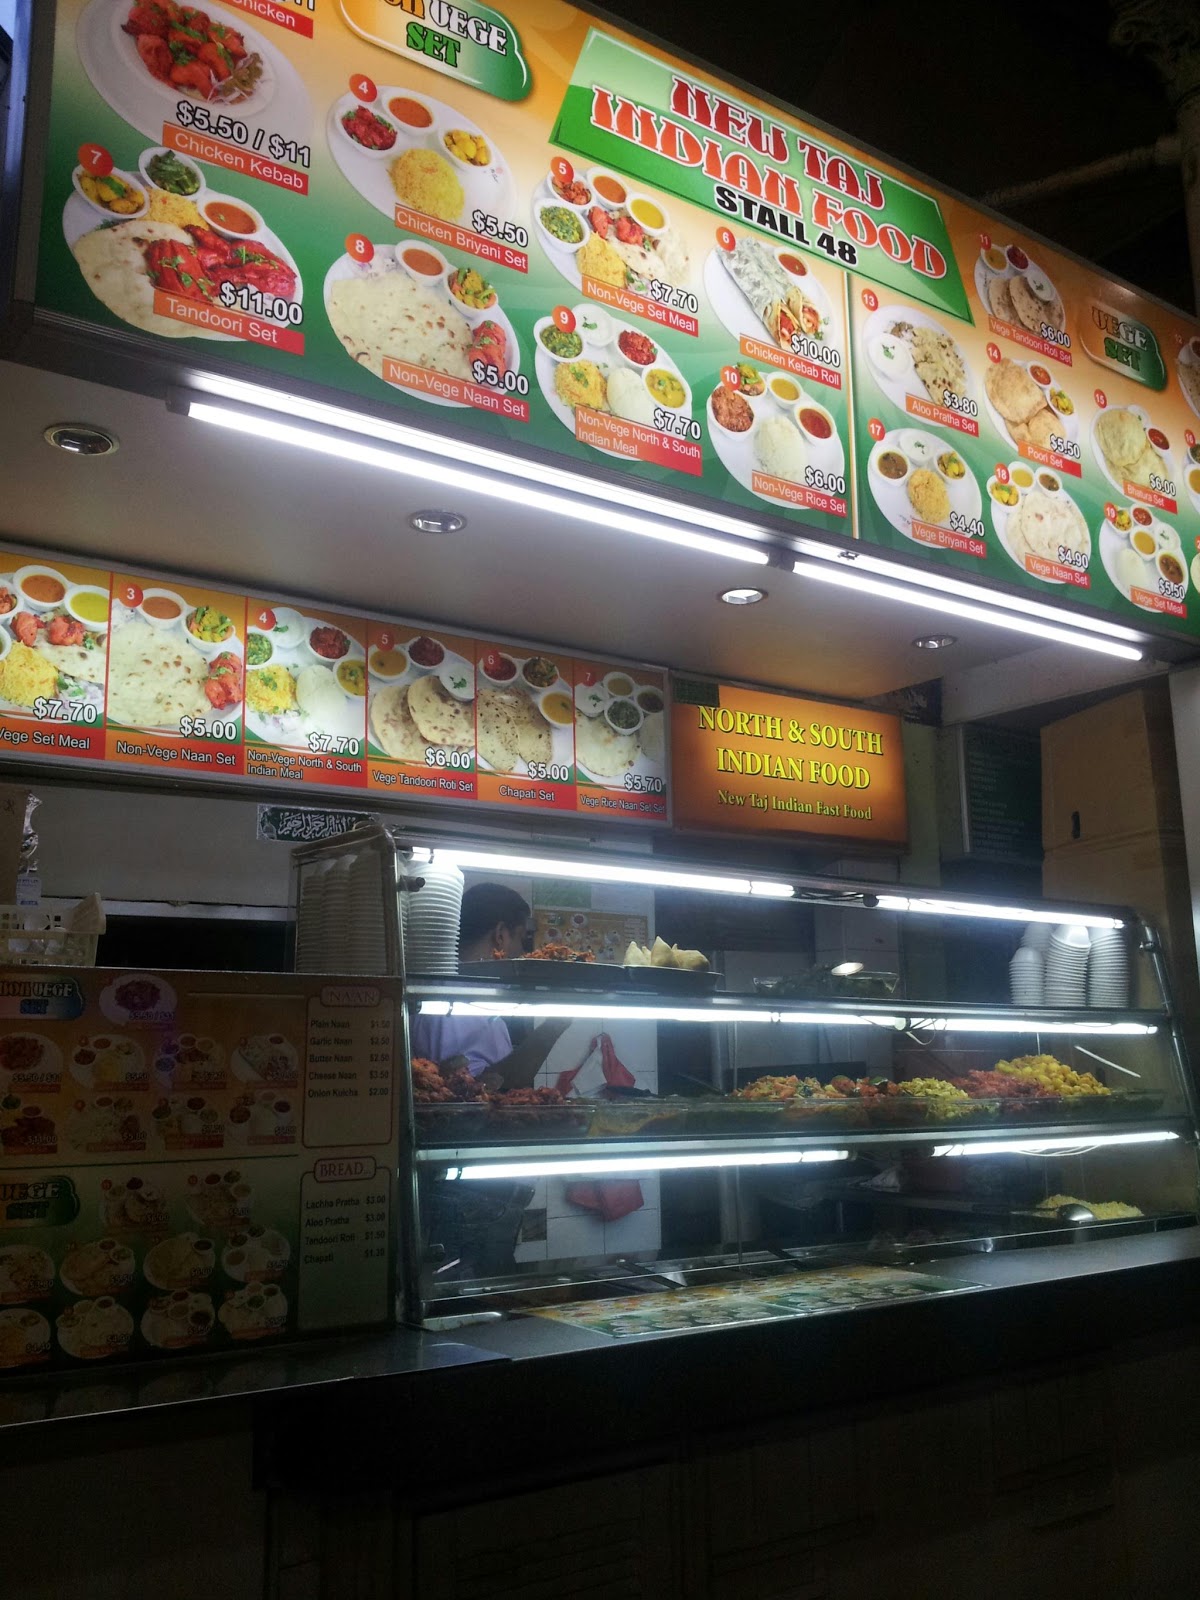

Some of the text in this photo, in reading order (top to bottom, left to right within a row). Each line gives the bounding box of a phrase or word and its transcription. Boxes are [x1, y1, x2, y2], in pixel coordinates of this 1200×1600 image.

[406, 22, 461, 68] SET
[358, 82, 369, 94] 4
[176, 101, 311, 168] $5.50 / $11
[669, 75, 886, 211] NEW TAJ
[91, 150, 101, 165] 7
[175, 133, 303, 189] Chicken Kebab
[558, 163, 567, 174] 5
[591, 84, 947, 280] INDIAN FOOD
[472, 210, 528, 248] $5.50
[715, 184, 858, 267] STALL 48
[722, 231, 730, 242] 6
[355, 240, 365, 253] 8
[397, 212, 527, 269] Chicken Briyani Set
[980, 234, 989, 246] 11
[220, 281, 303, 325] $11.00
[587, 281, 695, 332] Non-Vege Set Meal
[650, 278, 699, 313] $7.70
[863, 294, 875, 307] 13
[167, 298, 277, 344] Tandoori Set
[560, 311, 568, 324] 9
[990, 321, 1072, 364] Vege Tandoori Roti Set
[1040, 322, 1071, 348] $6.00
[790, 334, 840, 368] $10.00
[988, 347, 999, 359] 14
[1103, 337, 1141, 371] SET
[745, 342, 840, 386] Chicken Kebab Roll
[472, 359, 529, 395] $5.00
[725, 373, 738, 384] 10
[390, 363, 525, 417] Non-Vege Naan Set
[942, 388, 978, 417] $3.80
[1095, 393, 1105, 405] 15
[653, 408, 701, 440] $7.70
[870, 424, 882, 435] 17
[912, 402, 976, 433] Aloo Pratha Set
[578, 412, 700, 458] Non-Vege North & South
[578, 429, 638, 456] Indian Meal
[1049, 434, 1080, 460] $5.50
[1027, 447, 1064, 469] Poori Set
[804, 465, 846, 495] $6.00
[996, 469, 1007, 479] 18
[1149, 473, 1176, 497] $6.00
[754, 476, 846, 513] Non-Vege Rice Set
[1152, 493, 1165, 507] Set
[949, 511, 985, 538] $4.40
[914, 525, 984, 555] Vege Briyani Set
[1058, 545, 1089, 570] $4.90
[1030, 559, 1088, 585] Vege Naan Set
[127, 588, 135, 600] 3
[1158, 578, 1185, 600] $5.50
[1135, 590, 1184, 615] Vege Set Meal
[259, 612, 267, 623] 4
[381, 634, 389, 645] 5
[488, 655, 495, 665] 6
[586, 672, 592, 682] 7
[33, 696, 97, 725] $7.70
[180, 715, 237, 741] $5.00
[698, 705, 883, 756] NORTH & SOUTH
[32, 732, 90, 750] Set Meal
[116, 741, 236, 766] Non-Vege Naan Set
[308, 732, 360, 756] $7.70
[248, 750, 362, 773] Non-Vege North & South
[425, 748, 471, 769] $6.00
[716, 747, 870, 790] INDIAN FOOD
[248, 764, 304, 780] Indian Meal
[373, 770, 474, 793] Vege Tandoori Roti Set
[527, 761, 569, 782] $5.00
[624, 773, 663, 794] $5.70
[499, 785, 555, 802] Chapati Set
[580, 796, 600, 809] Vege
[600, 798, 617, 809] Rice
[619, 799, 638, 811] Naan
[718, 789, 872, 821] New Taj Indian Fast Food
